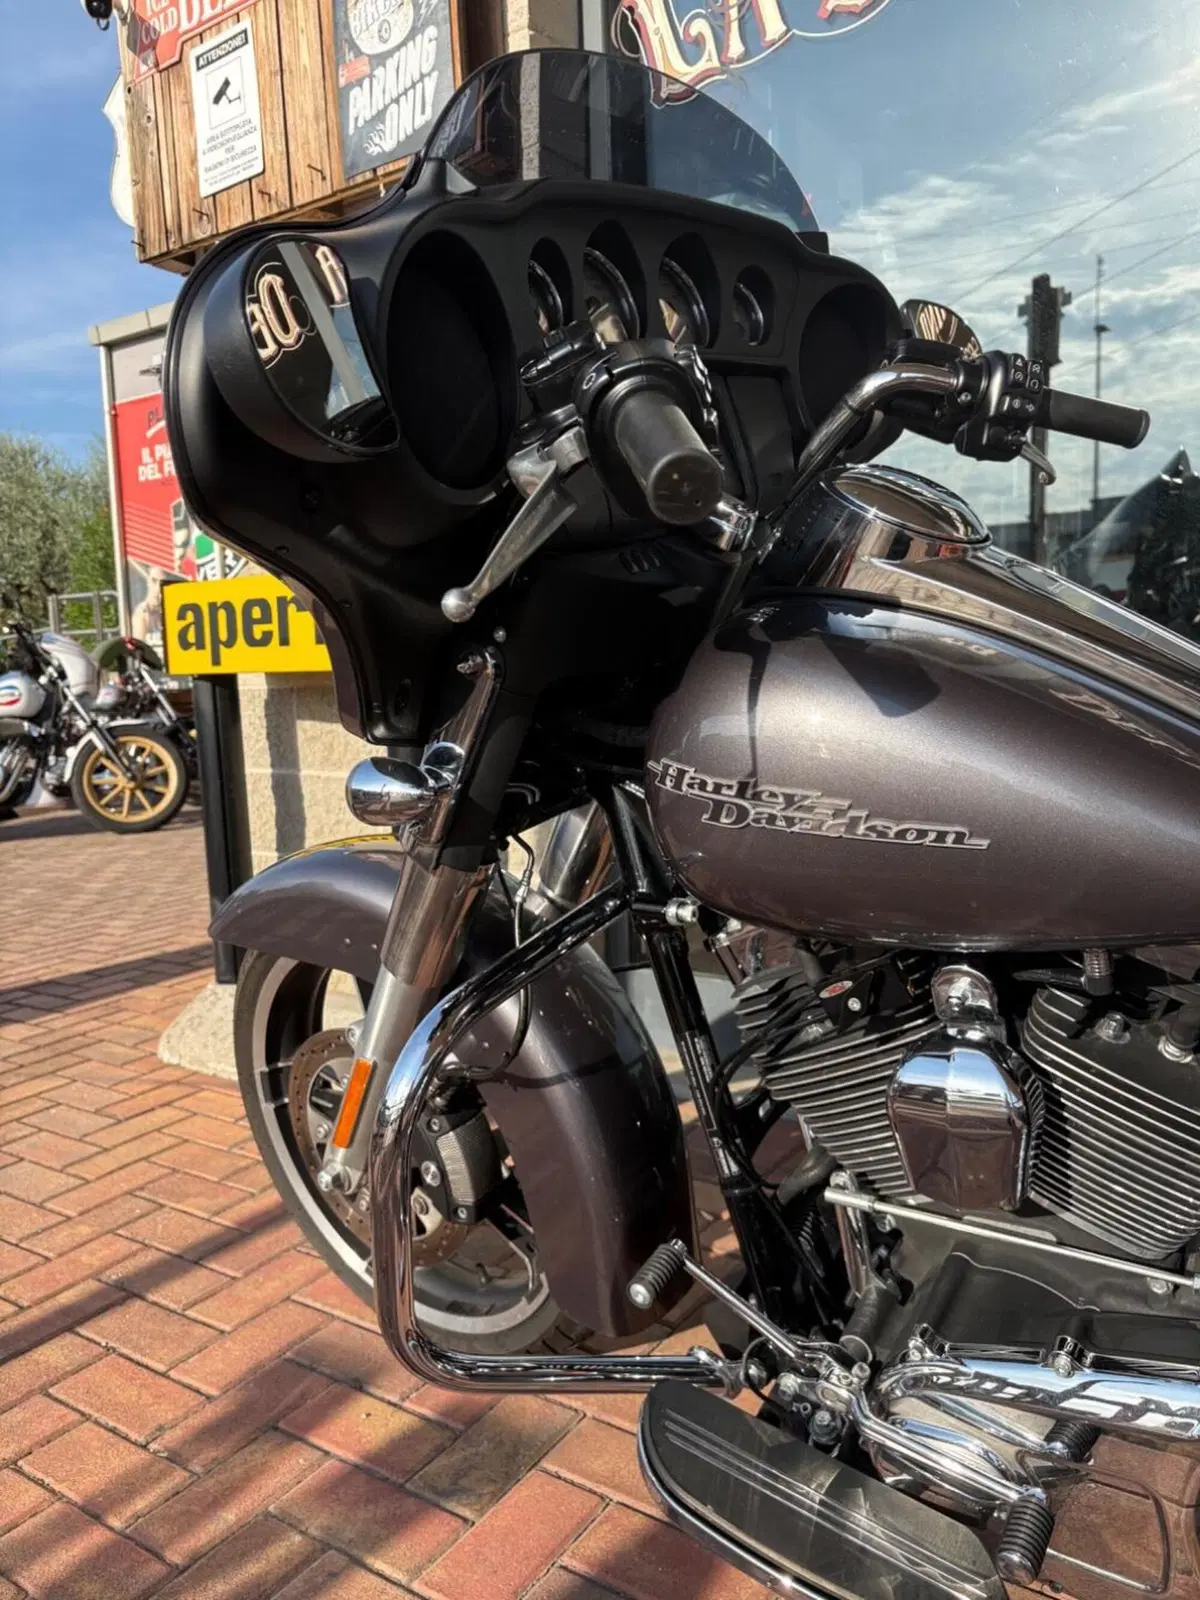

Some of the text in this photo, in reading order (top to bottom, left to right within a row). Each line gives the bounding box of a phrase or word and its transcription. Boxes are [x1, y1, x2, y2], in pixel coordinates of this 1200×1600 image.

[141, 6, 178, 44] COLD
[198, 33, 246, 68] ATTENZIONE!
[348, 25, 438, 136] PARKING
[382, 70, 439, 153] ONLY
[137, 462, 162, 483] DEL
[647, 757, 851, 813] Harley
[701, 799, 990, 850] Davidson
